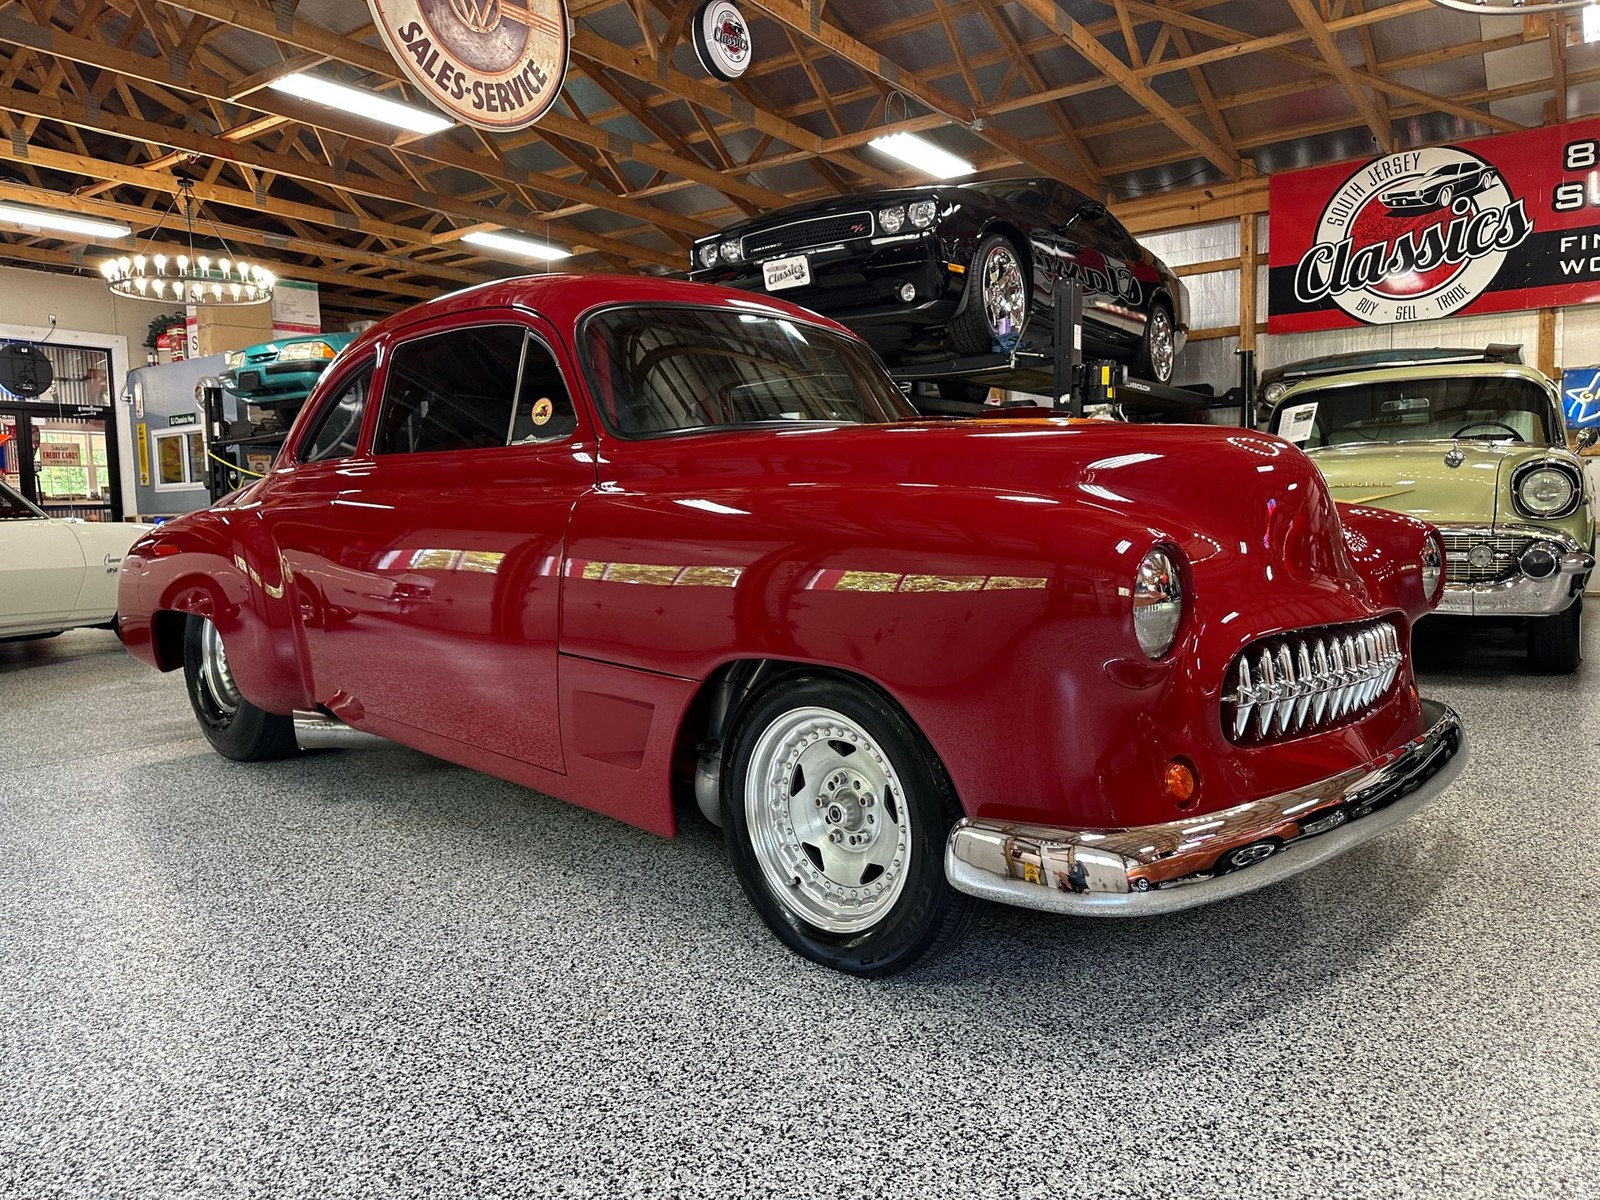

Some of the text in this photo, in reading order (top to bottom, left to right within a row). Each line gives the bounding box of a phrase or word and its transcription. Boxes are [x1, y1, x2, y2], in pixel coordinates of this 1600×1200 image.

[714, 26, 749, 51] Classics
[397, 21, 548, 113] SALES-SERVICE
[1326, 152, 1422, 227] SOUTH JERSEY
[1295, 197, 1534, 302] Classics
[767, 263, 804, 285] Classics
[1355, 282, 1471, 320] BUY SELL TRADE
[42, 451, 79, 460] CREDIT CARDS
